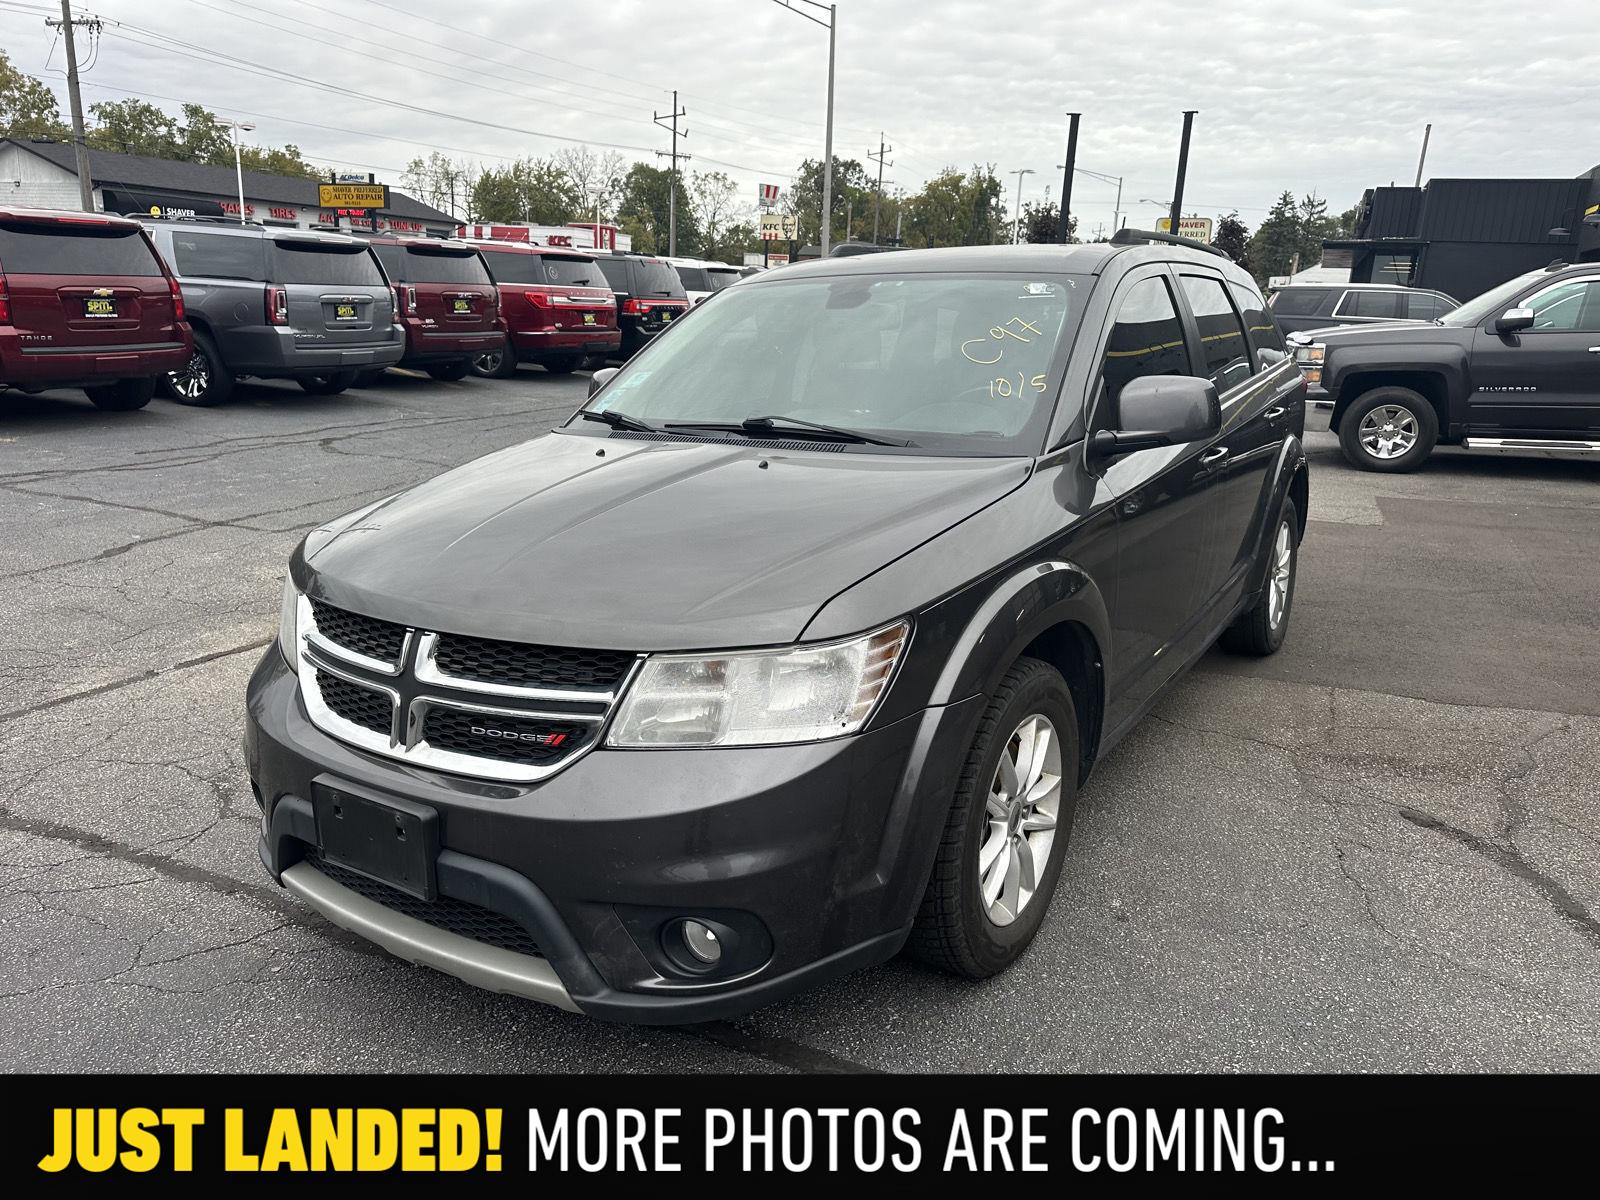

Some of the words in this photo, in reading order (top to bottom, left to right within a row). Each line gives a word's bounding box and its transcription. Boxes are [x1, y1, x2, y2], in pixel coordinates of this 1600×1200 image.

[355, 193, 383, 201] REPAIR
[166, 207, 195, 217] SHAVER
[269, 206, 298, 219] TIRES
[763, 223, 780, 231] KFC
[1178, 221, 1206, 229] HAVER
[547, 235, 572, 247] KFC
[471, 726, 552, 743] DODGE
